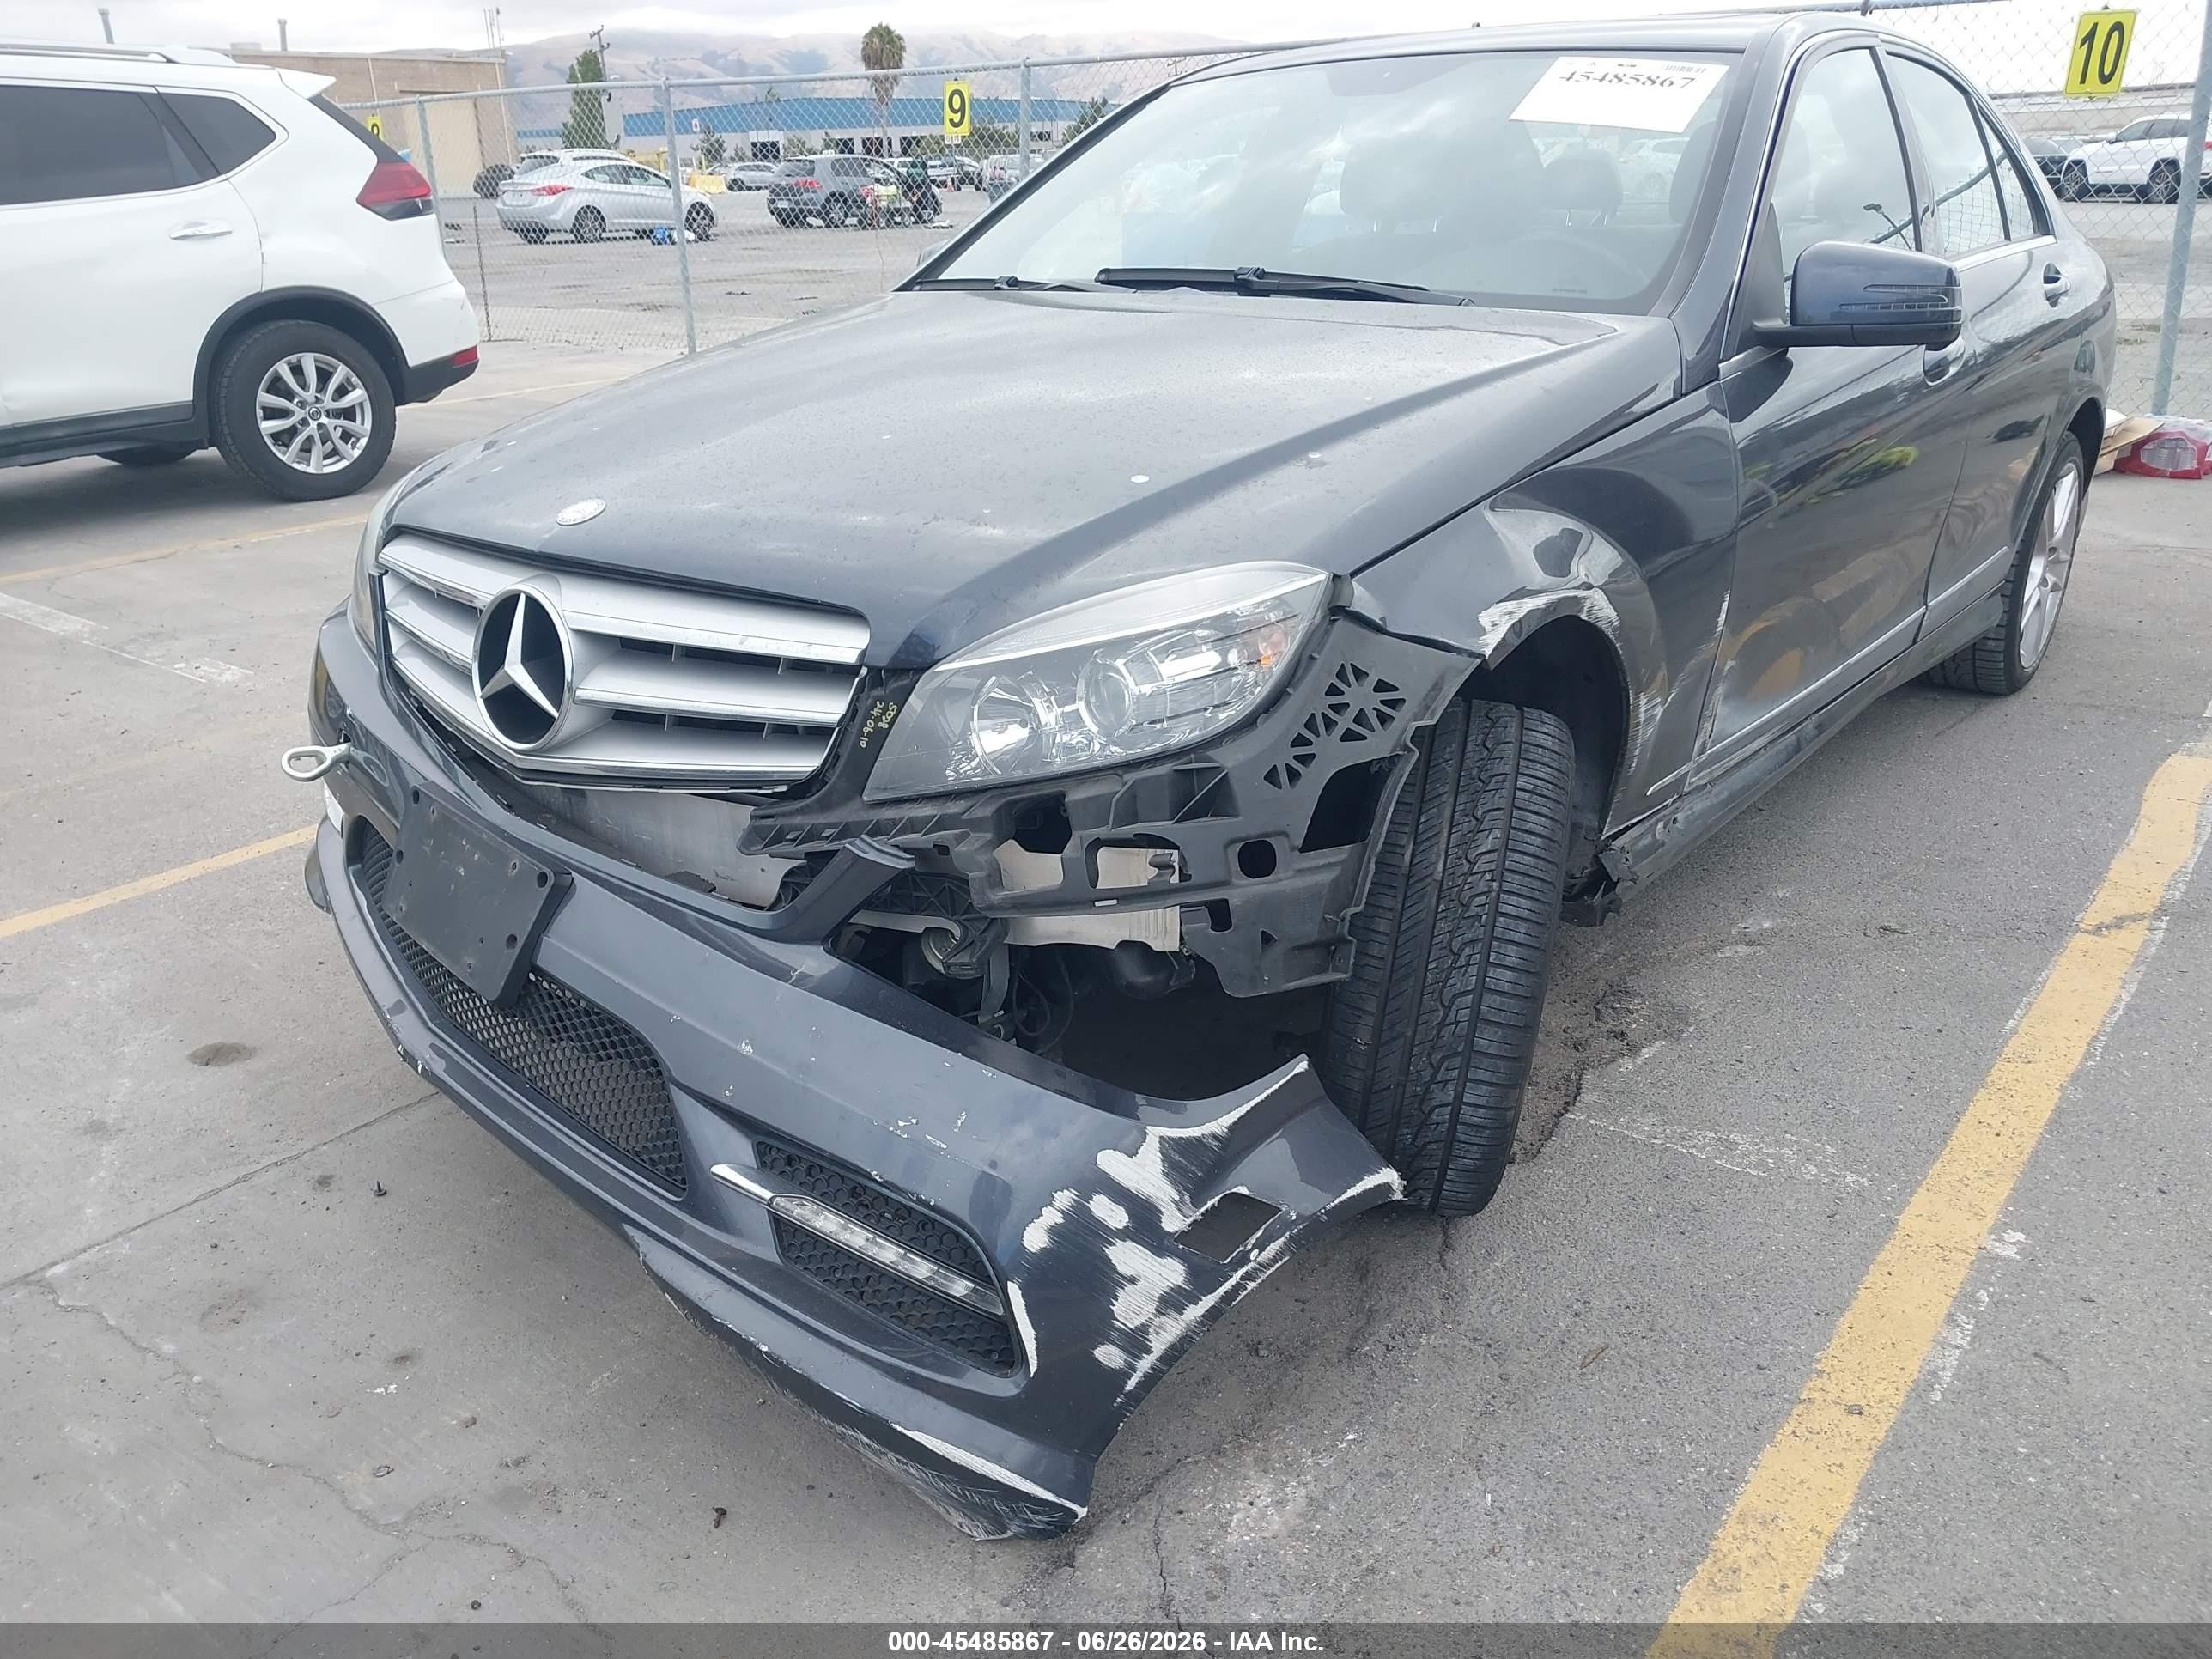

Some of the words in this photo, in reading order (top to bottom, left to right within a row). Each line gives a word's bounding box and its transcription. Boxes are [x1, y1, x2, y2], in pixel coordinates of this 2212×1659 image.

[2079, 21, 2125, 85] 10
[1559, 70, 1696, 89] 45485867
[948, 88, 966, 128] 9
